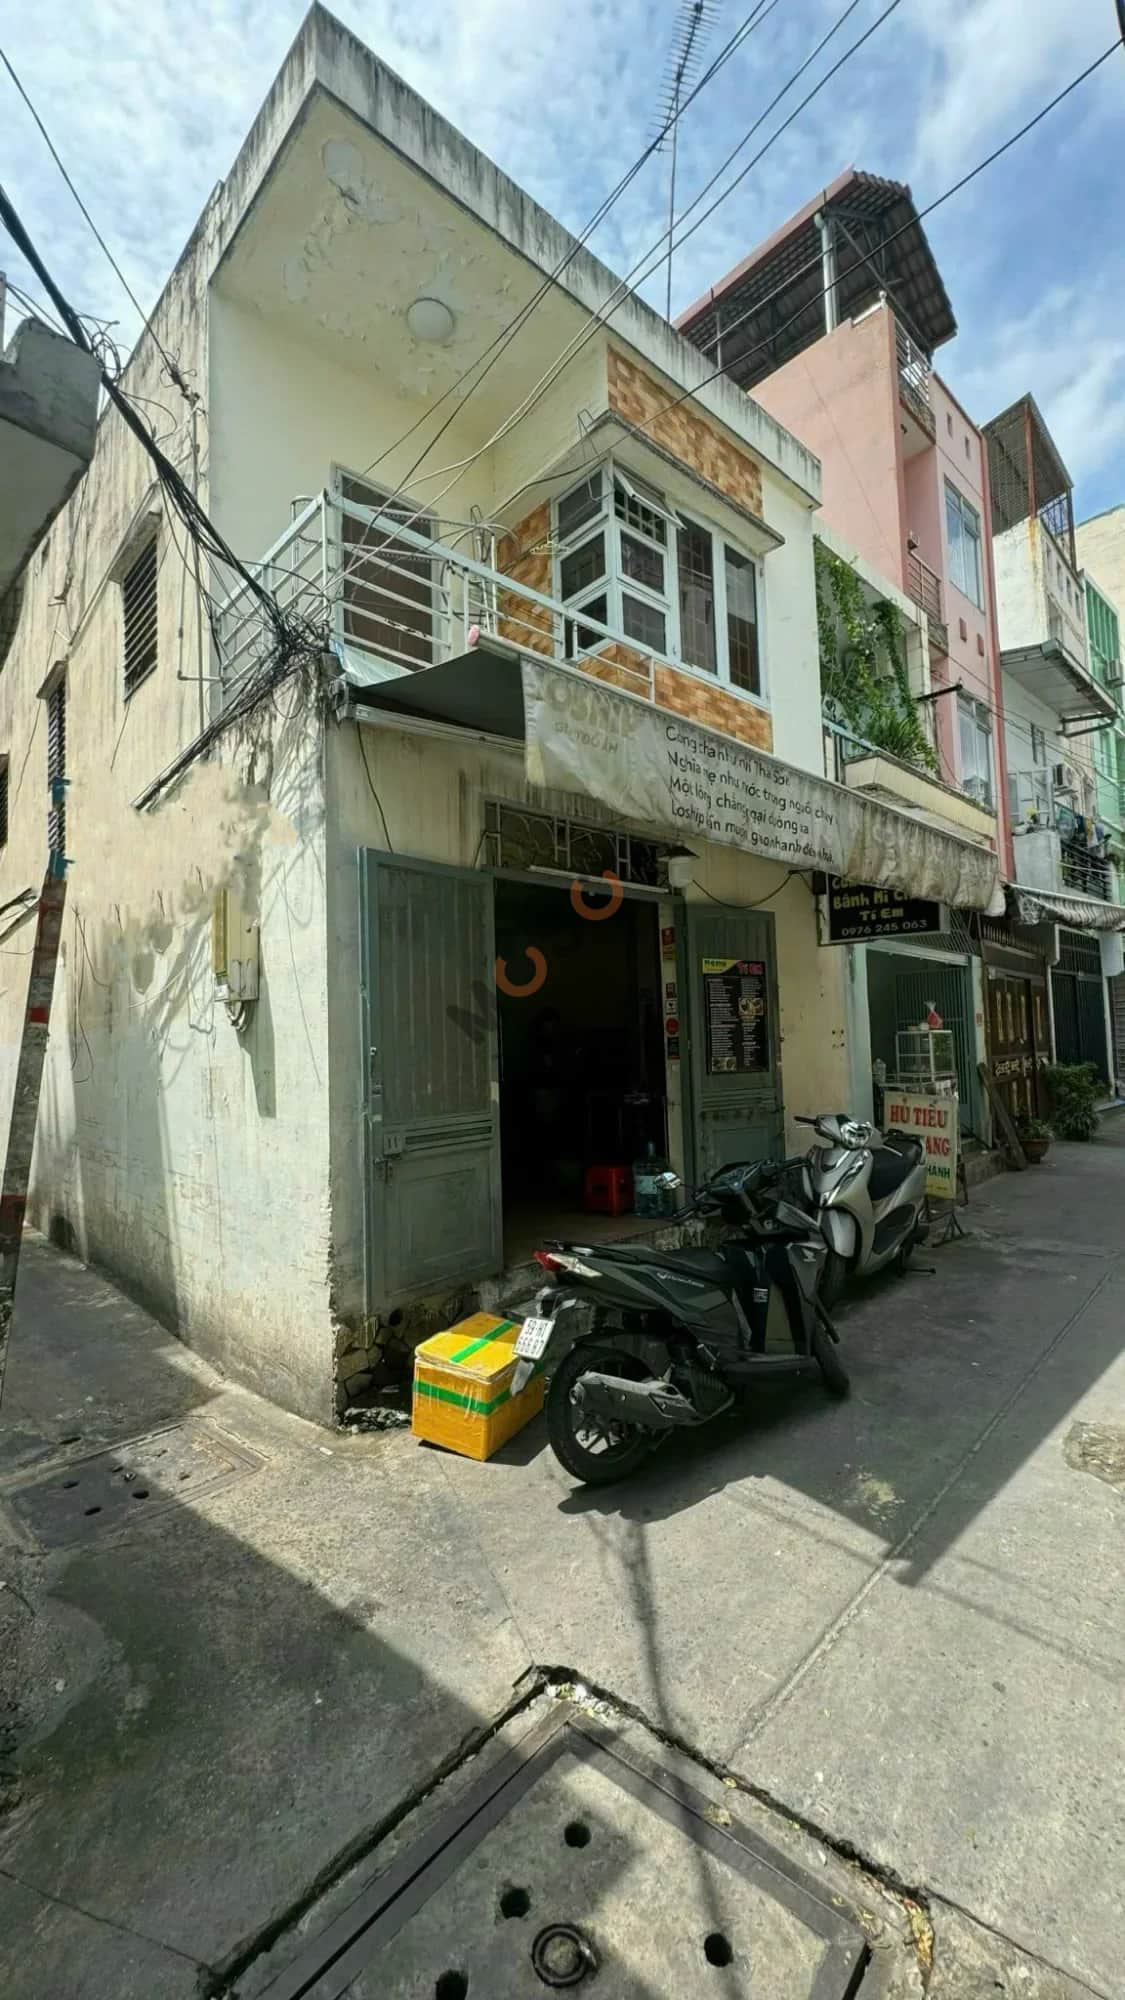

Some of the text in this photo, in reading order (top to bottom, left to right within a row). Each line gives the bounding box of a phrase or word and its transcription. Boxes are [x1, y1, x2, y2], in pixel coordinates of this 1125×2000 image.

[671, 799, 704, 828] Loship
[815, 807, 833, 825] chy
[841, 919, 927, 937] 0976 245 063
[925, 1135, 951, 1157] ANG
